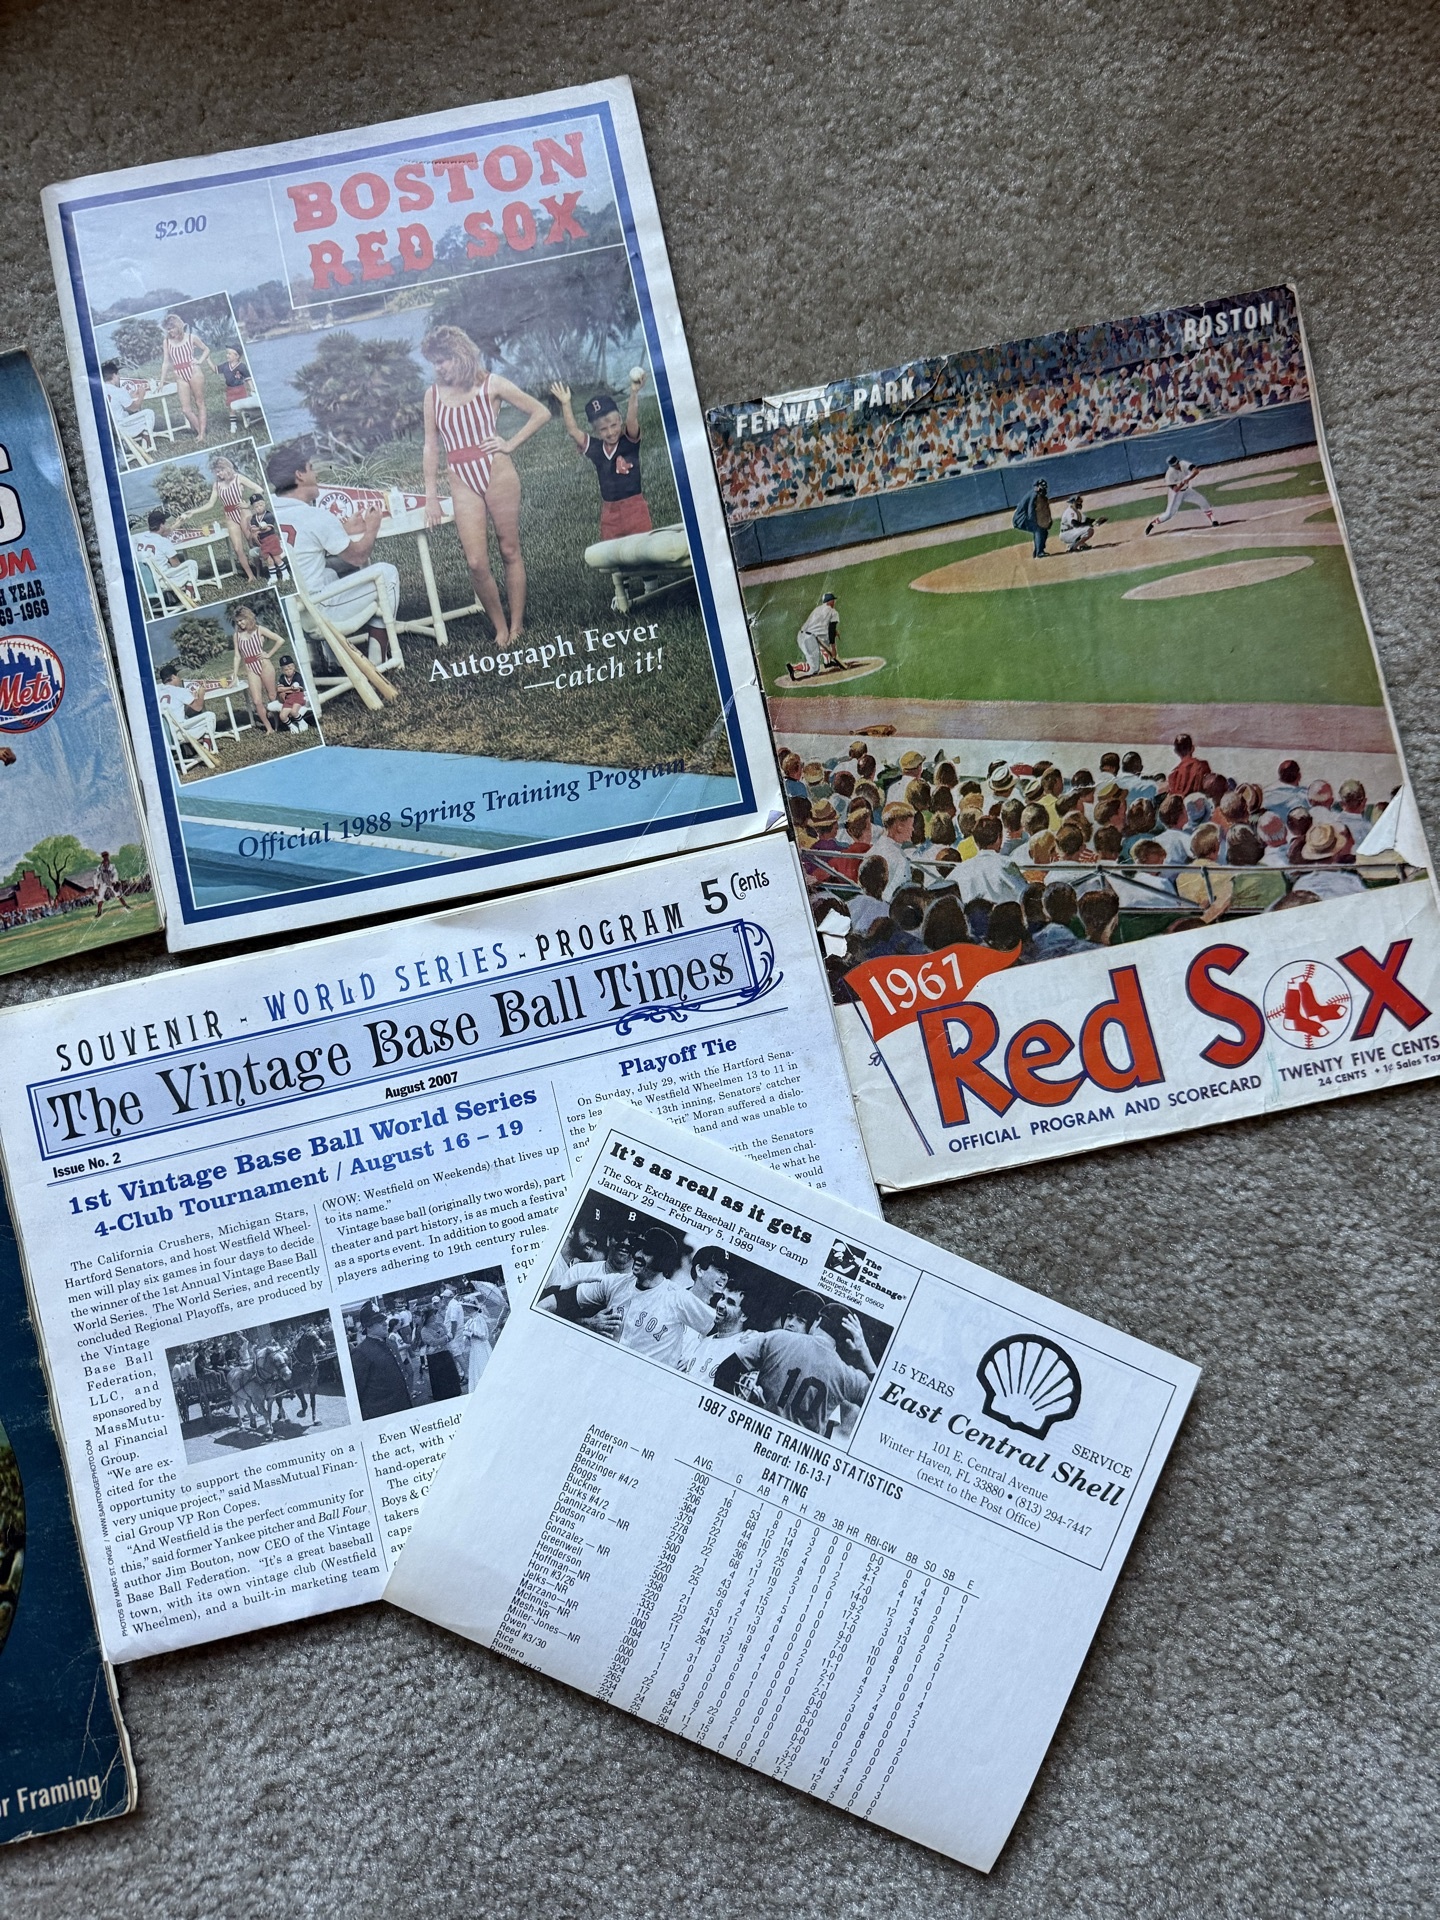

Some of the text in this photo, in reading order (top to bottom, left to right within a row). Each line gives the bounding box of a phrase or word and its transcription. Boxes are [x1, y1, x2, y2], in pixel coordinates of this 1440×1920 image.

[286, 131, 589, 234] BOSTON
[154, 214, 208, 241] $2.00
[308, 190, 590, 290] RED SOX
[1183, 300, 1275, 346] BOSTON
[736, 375, 917, 438] FENWAY PARK
[8, 579, 45, 601] YEAR
[428, 622, 659, 683] Autograph Fever
[634, 647, 663, 675] it!
[0, 671, 52, 712] Mets
[238, 758, 686, 861] Official 1988 Spring Training Program
[700, 868, 770, 915] 5 Cents
[56, 902, 685, 1072] SOUVENIR WORLD SERIES PROGRAM
[868, 951, 966, 1016] 1967
[46, 950, 734, 1142] The Vintage Base Ball Times
[618, 1038, 737, 1077] Playoff Tie
[637, 1051, 794, 1092] July 29, with the Hartford Sena-
[917, 963, 1165, 1129] Red
[1318, 1077, 1332, 1087] 24
[1335, 1069, 1367, 1083] CENTS
[1396, 1058, 1422, 1070] Sales
[385, 1071, 458, 1099] August 2007
[947, 1034, 1439, 1154] OFFICIAL PROGRAM AND SCORECARD TWENTY FIVE CENTS
[53, 1152, 121, 1178] Issue No. 2
[69, 1090, 537, 1215] 1st Vintage Base Ball World Series
[94, 1120, 523, 1237] 4-Club Tournament August 16 19
[597, 1177, 639, 1201] January
[641, 1196, 655, 1207] 29
[668, 1208, 714, 1235] February
[729, 1235, 754, 1252] 1989
[603, 1165, 808, 1266] The Sox Exchange Baseball Fantasy Camp
[610, 1142, 812, 1244] It's as real as it gets
[70, 1209, 308, 1272] The California Crushers, Michigan Stars,
[866, 1258, 882, 1271] The
[855, 1289, 865, 1300] VT
[861, 1266, 879, 1280] Sox
[892, 1361, 955, 1397] 15 YEARS
[577, 1443, 608, 1464] Baylor
[582, 1433, 614, 1454] Barrett
[586, 1424, 655, 1461] Anderson NR
[698, 1395, 903, 1500] 1987 SPRING TRAINING STATISTICS
[753, 1441, 831, 1486] Record: 16-13-1
[879, 1381, 1125, 1506] East Central Shell
[932, 1441, 1048, 1501] 101 E. Central Avenue
[1071, 1444, 1133, 1479] SERVICE
[761, 1467, 808, 1498] BATTING
[880, 1432, 1092, 1536] Winter Haven, FL 33880 (813) 294-7447
[917, 1468, 1041, 1532] (next to the Post Office)
[693, 1455, 713, 1471] AVG.
[736, 1474, 743, 1484] G
[757, 1484, 771, 1497] AB
[781, 1495, 789, 1505] R
[799, 1503, 808, 1514] H
[813, 1510, 826, 1522] 2B
[832, 1518, 845, 1530] 3B
[846, 1524, 860, 1538] HR
[864, 1533, 897, 1554] RBI-GW
[904, 1552, 920, 1565] BB
[942, 1568, 956, 1582] SB
[967, 1579, 975, 1591] E
[132, 1566, 380, 1634] Wheelmen), and a built-in marketing team
[16, 1774, 101, 1814] Framing
